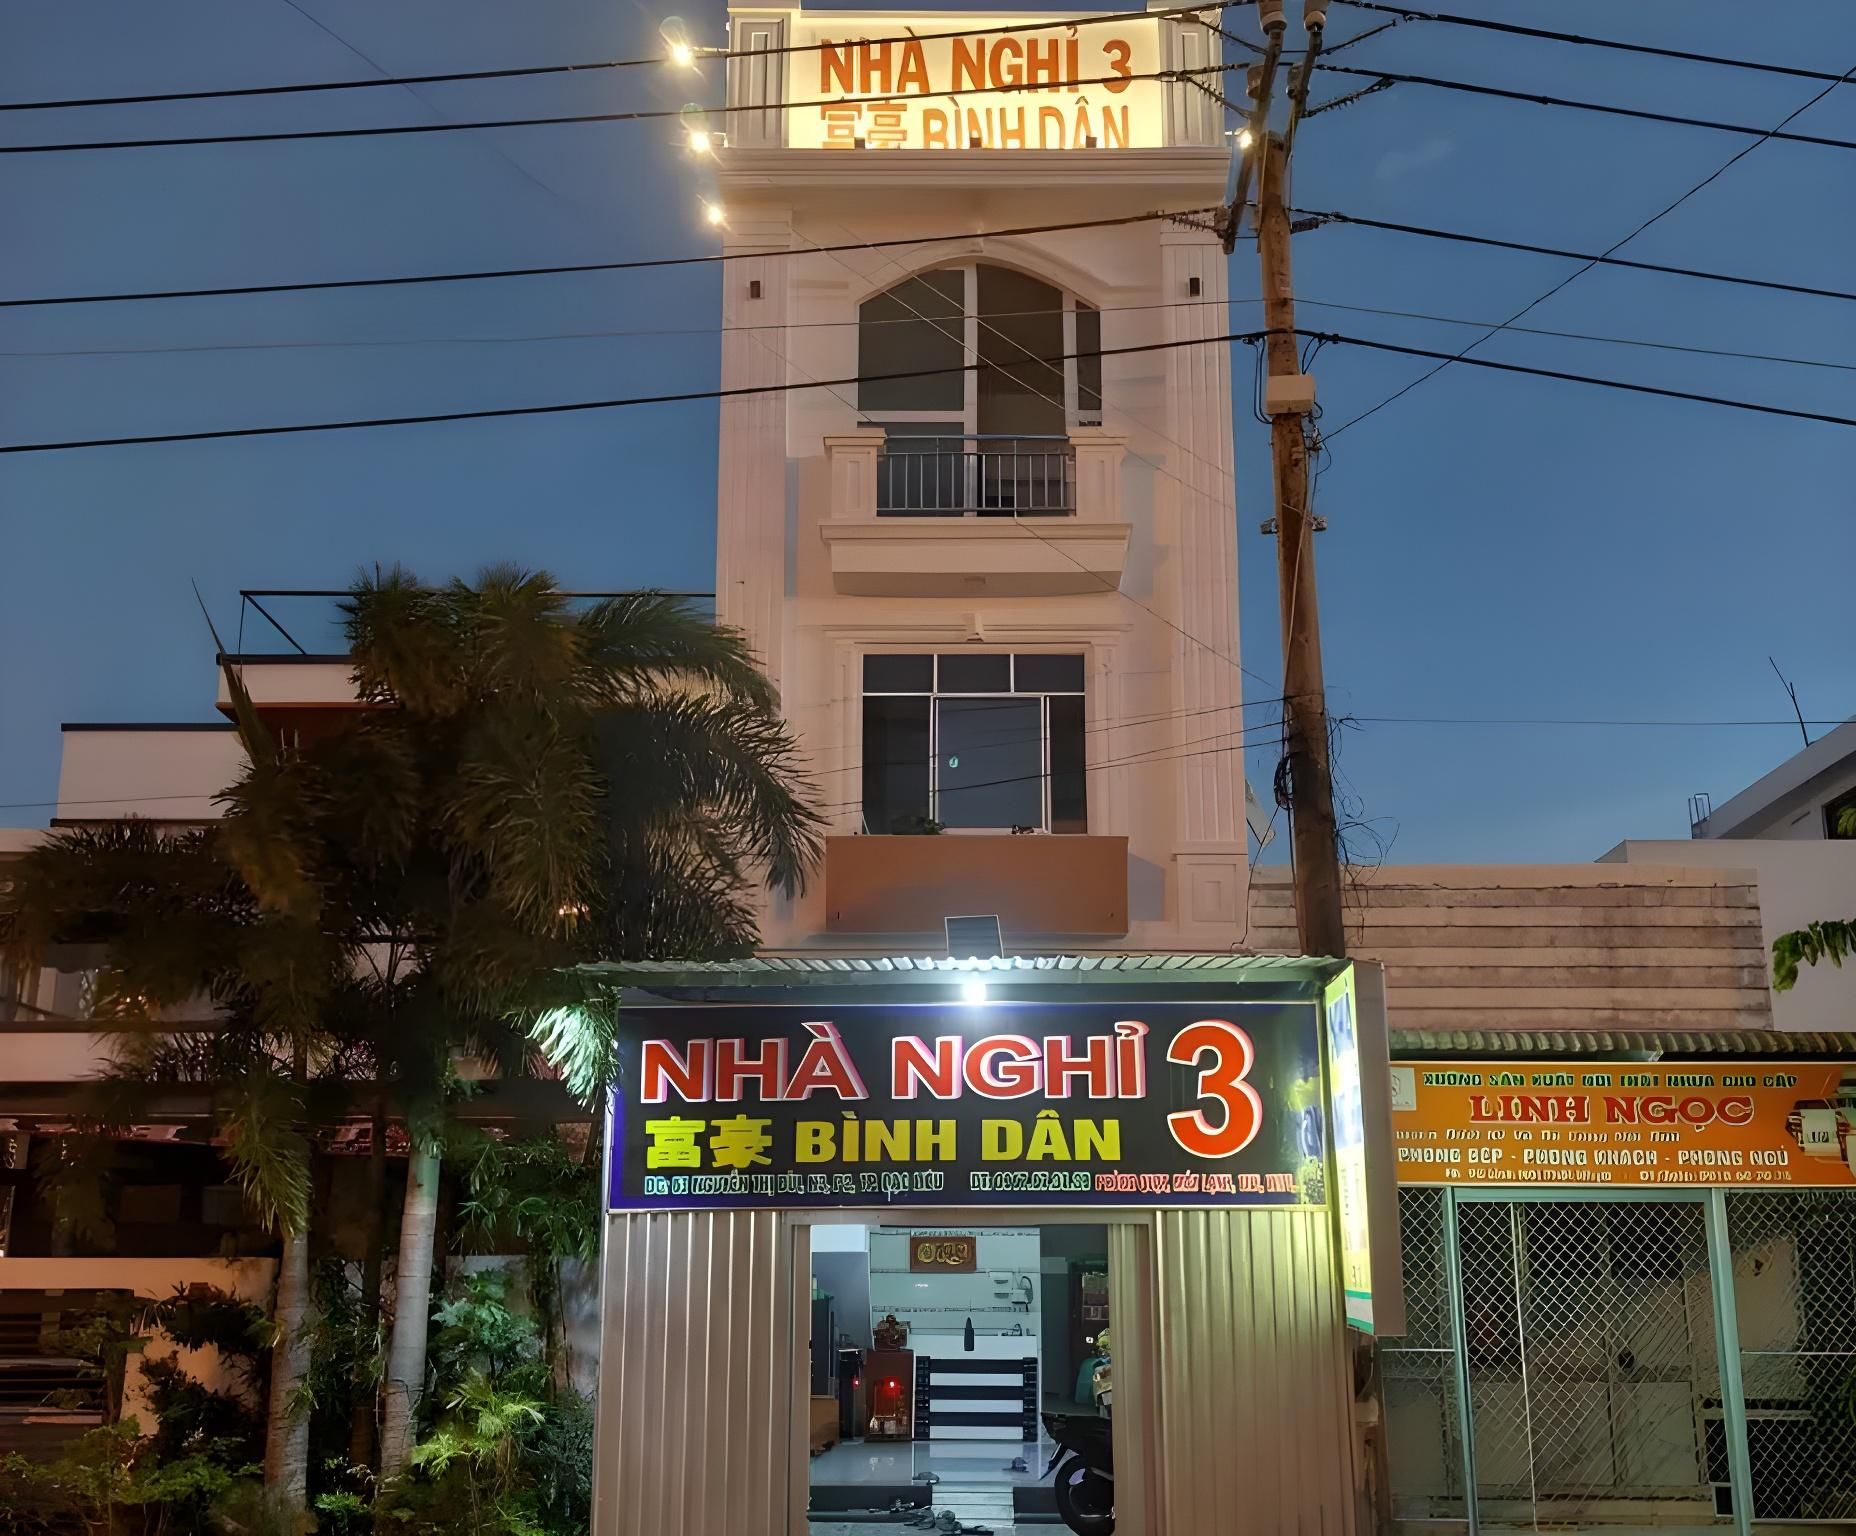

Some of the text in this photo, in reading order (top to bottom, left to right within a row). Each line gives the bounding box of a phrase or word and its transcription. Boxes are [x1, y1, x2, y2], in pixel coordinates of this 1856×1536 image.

[819, 26, 930, 94] NHÀ
[1102, 38, 1133, 94] 3
[923, 96, 1130, 149] BÌNH DÂN
[641, 1017, 1150, 1104] NHÀ NGHỈ
[1166, 1018, 1263, 1159] 3
[795, 1109, 1121, 1163] BÌNH DÂN
[1469, 1095, 1755, 1133] LINH NGỌC
